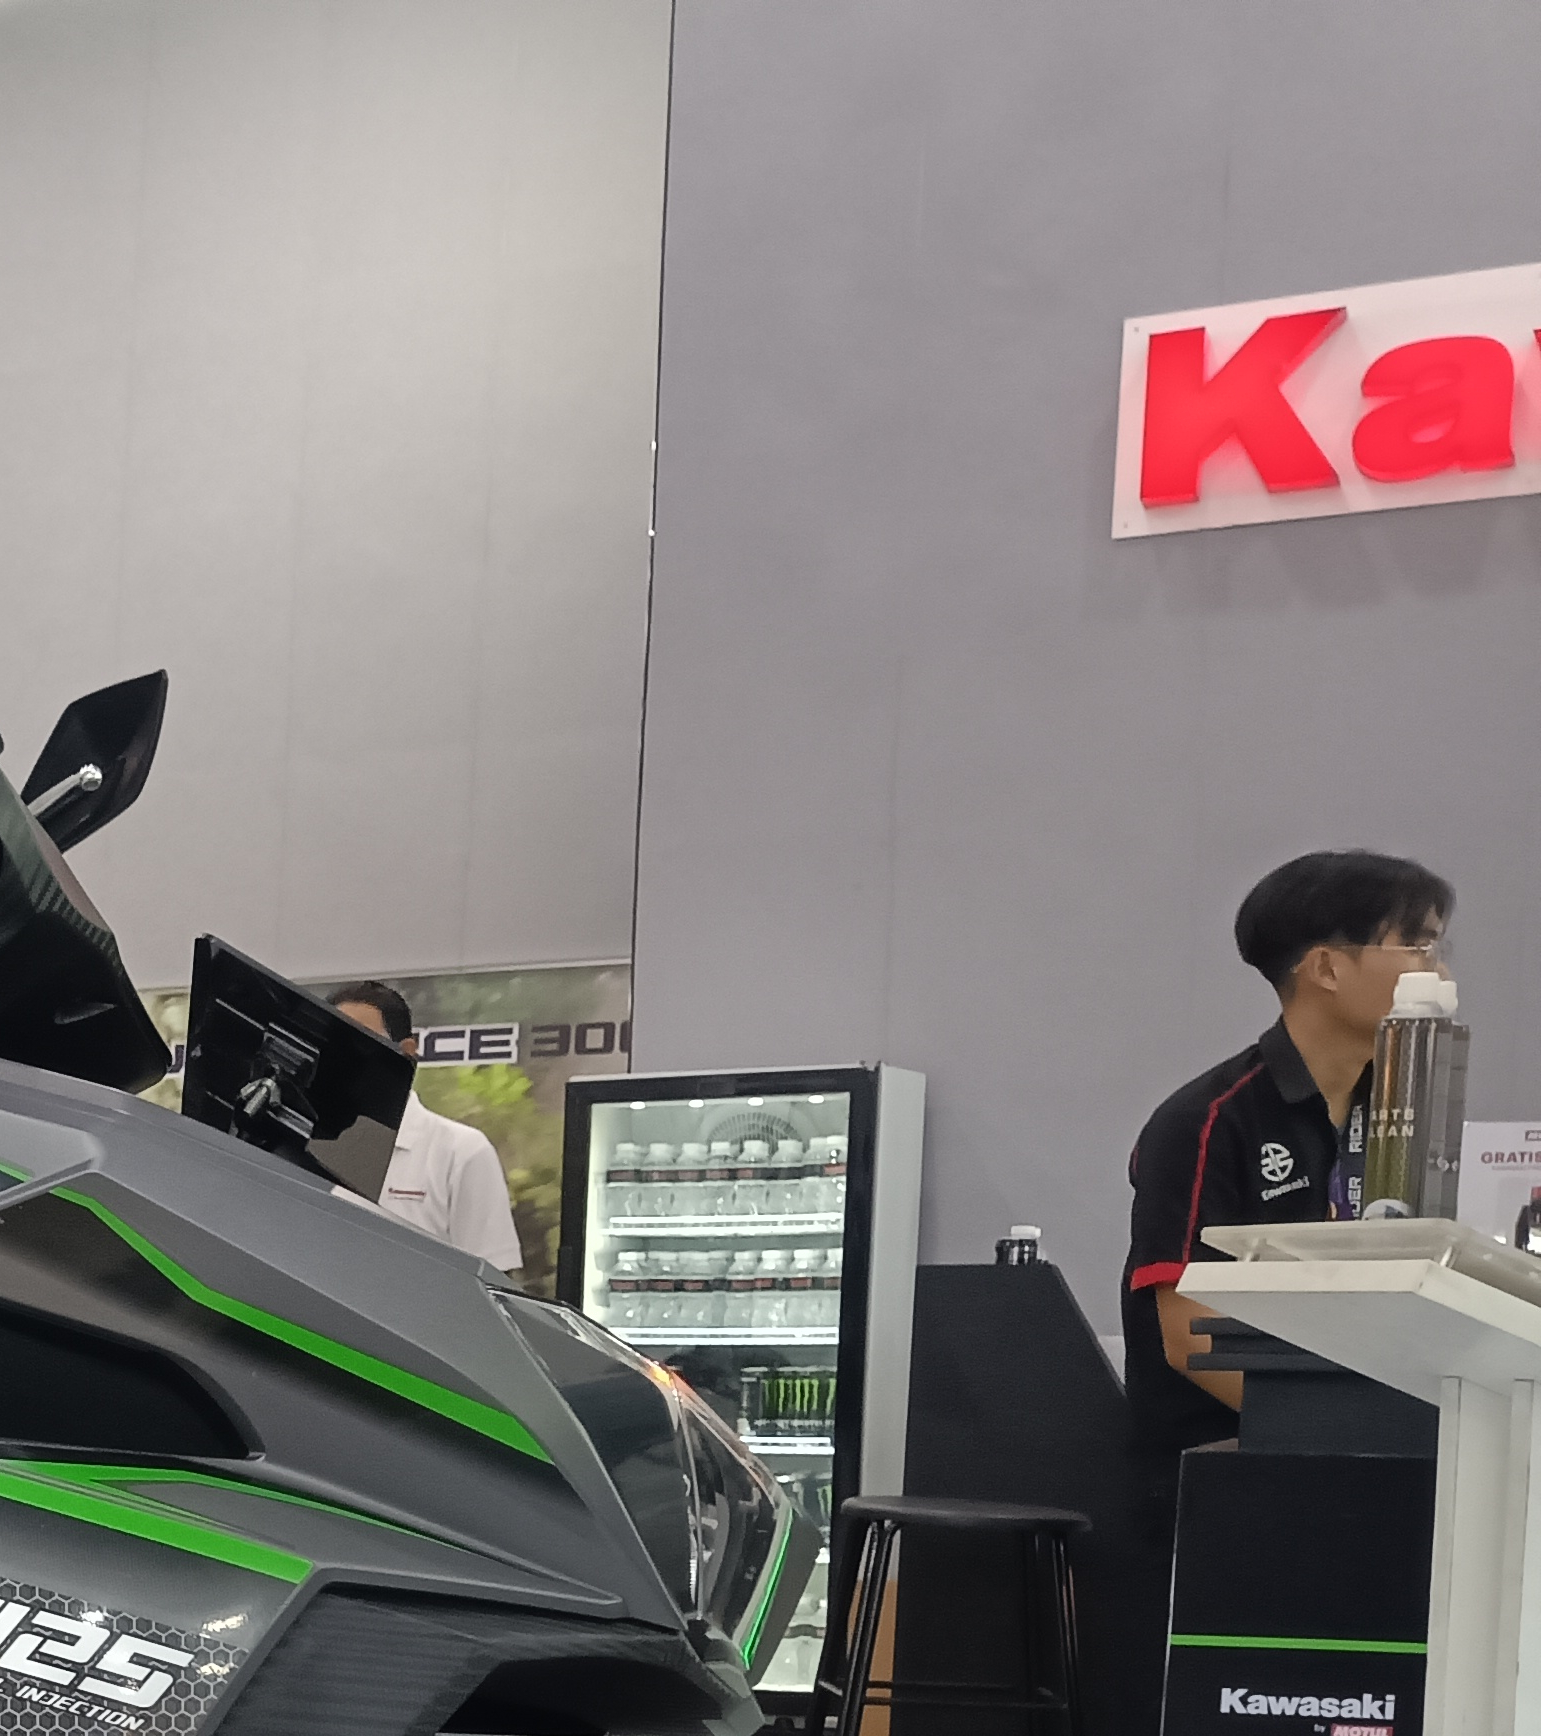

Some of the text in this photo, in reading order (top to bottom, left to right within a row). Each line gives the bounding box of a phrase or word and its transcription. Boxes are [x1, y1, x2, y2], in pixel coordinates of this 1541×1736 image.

[1140, 307, 1541, 509] Ka
[530, 1021, 630, 1058] 30
[15, 1684, 146, 1731] INJECTION
[1220, 1687, 1395, 1720] Kawasaki
